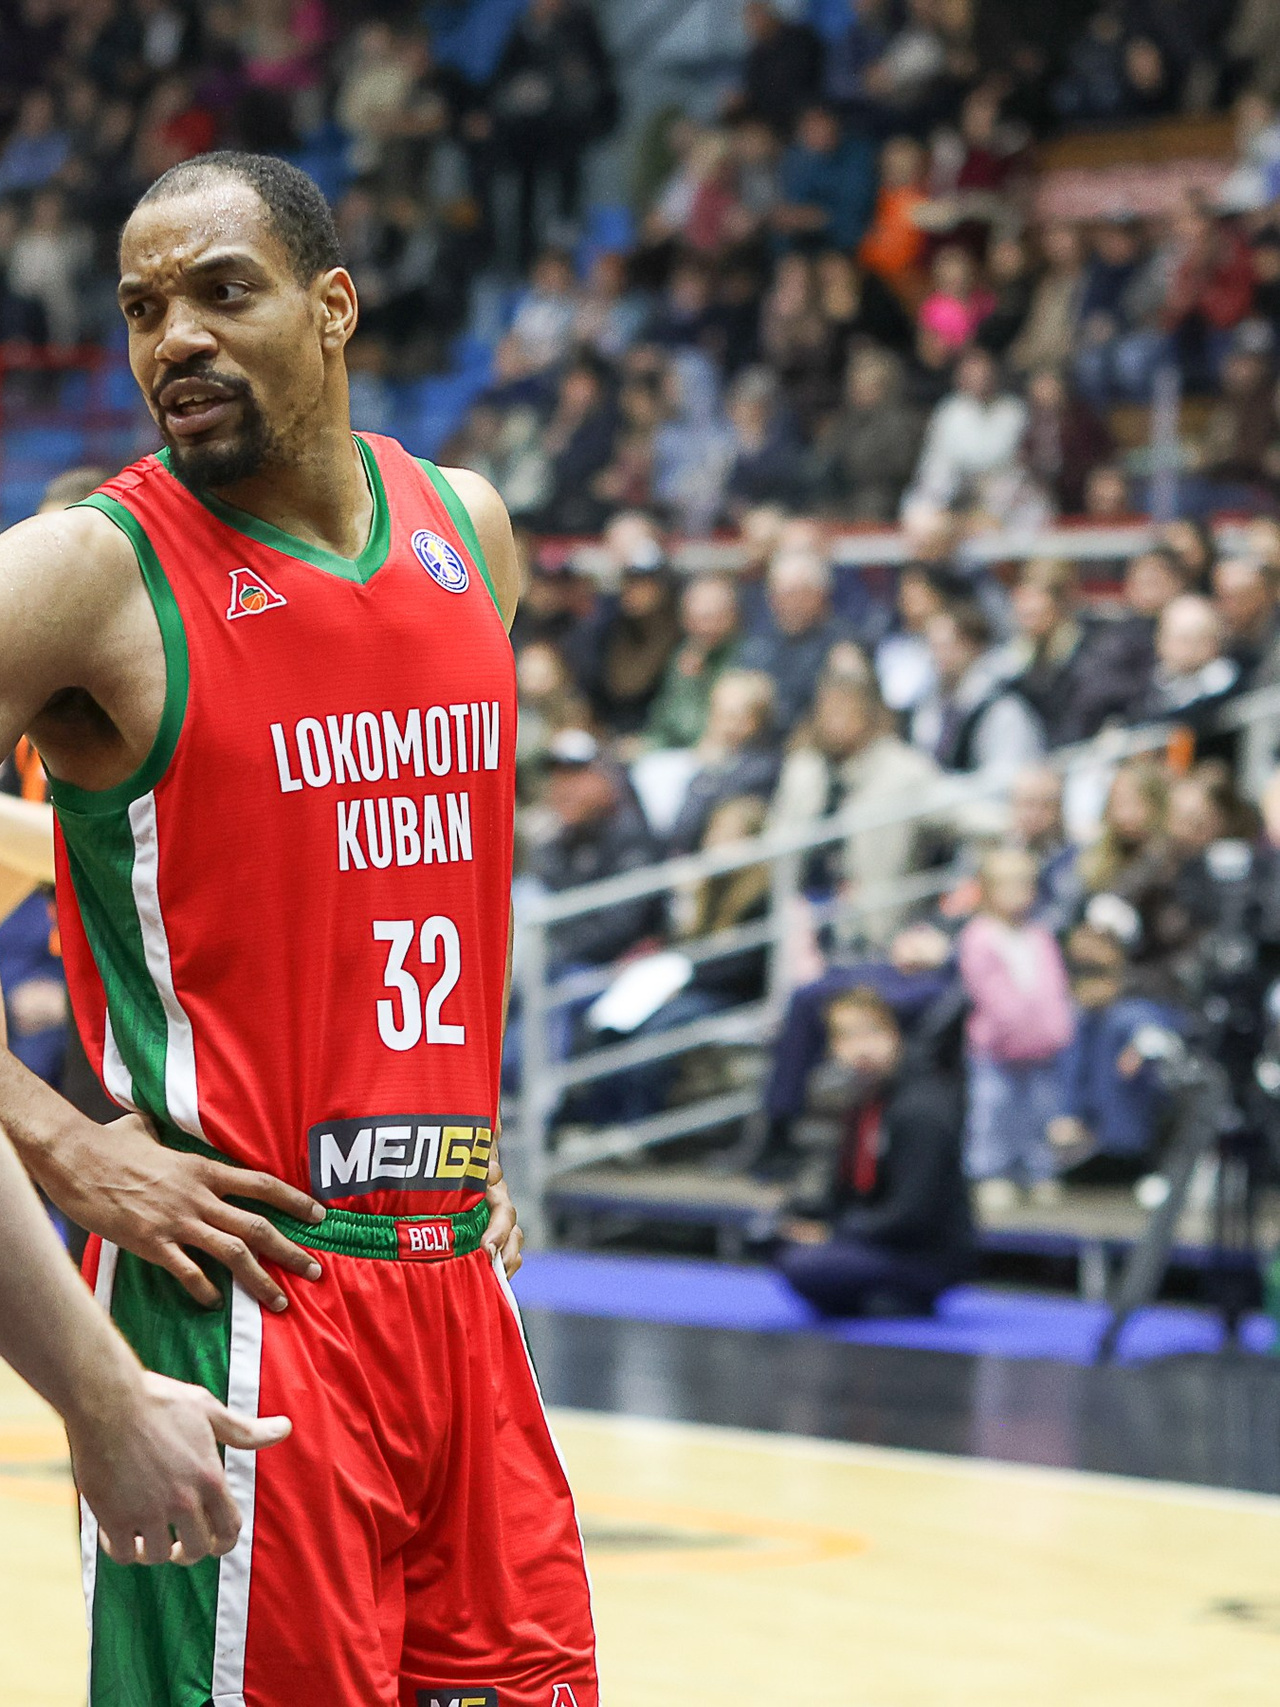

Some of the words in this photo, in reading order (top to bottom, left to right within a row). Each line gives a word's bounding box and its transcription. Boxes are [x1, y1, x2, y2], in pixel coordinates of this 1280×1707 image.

[270, 701, 500, 793] LOKOMOTIV
[337, 791, 473, 871] KUBAN
[372, 915, 465, 1051] 32
[407, 1225, 450, 1252] BCLK
